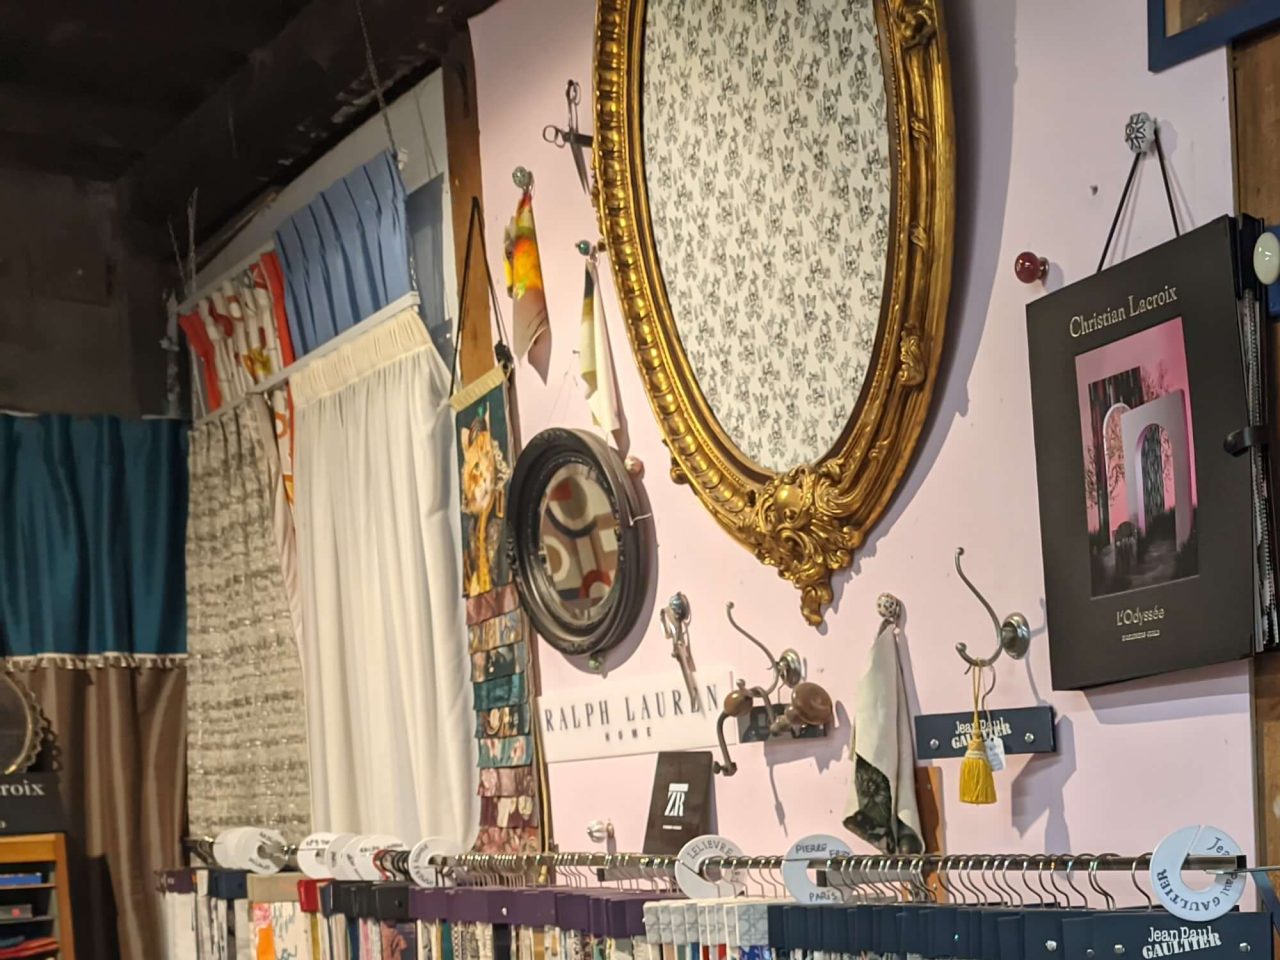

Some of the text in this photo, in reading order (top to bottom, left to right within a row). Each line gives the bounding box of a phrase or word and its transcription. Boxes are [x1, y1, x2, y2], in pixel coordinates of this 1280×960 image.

[1070, 285, 1178, 338] Christian Lacroix
[1116, 604, 1165, 626] L'Odyssée
[545, 684, 718, 732] RALPH LAUREN
[605, 726, 652, 742] HOME
[1206, 836, 1231, 857] Jea
[1156, 868, 1222, 912] GAULTIER
[1142, 932, 1222, 960] GAULTIER
[1147, 925, 1212, 943] Jean Paul
